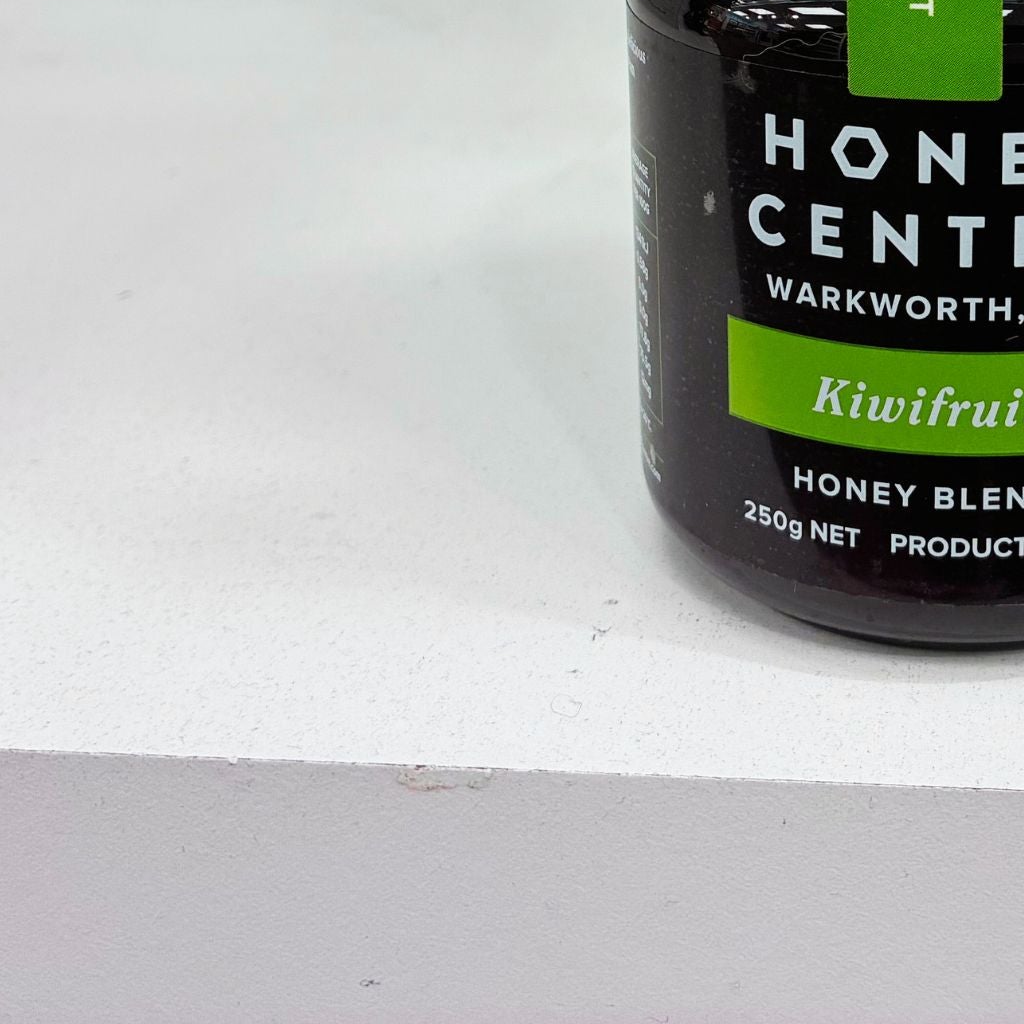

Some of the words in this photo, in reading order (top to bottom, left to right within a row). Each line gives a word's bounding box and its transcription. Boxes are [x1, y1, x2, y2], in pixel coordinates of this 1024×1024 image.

[766, 273, 1024, 325] WARKWORTH,
[794, 465, 917, 507] HONEY
[744, 499, 803, 541] 250g
[810, 519, 861, 548] NET
